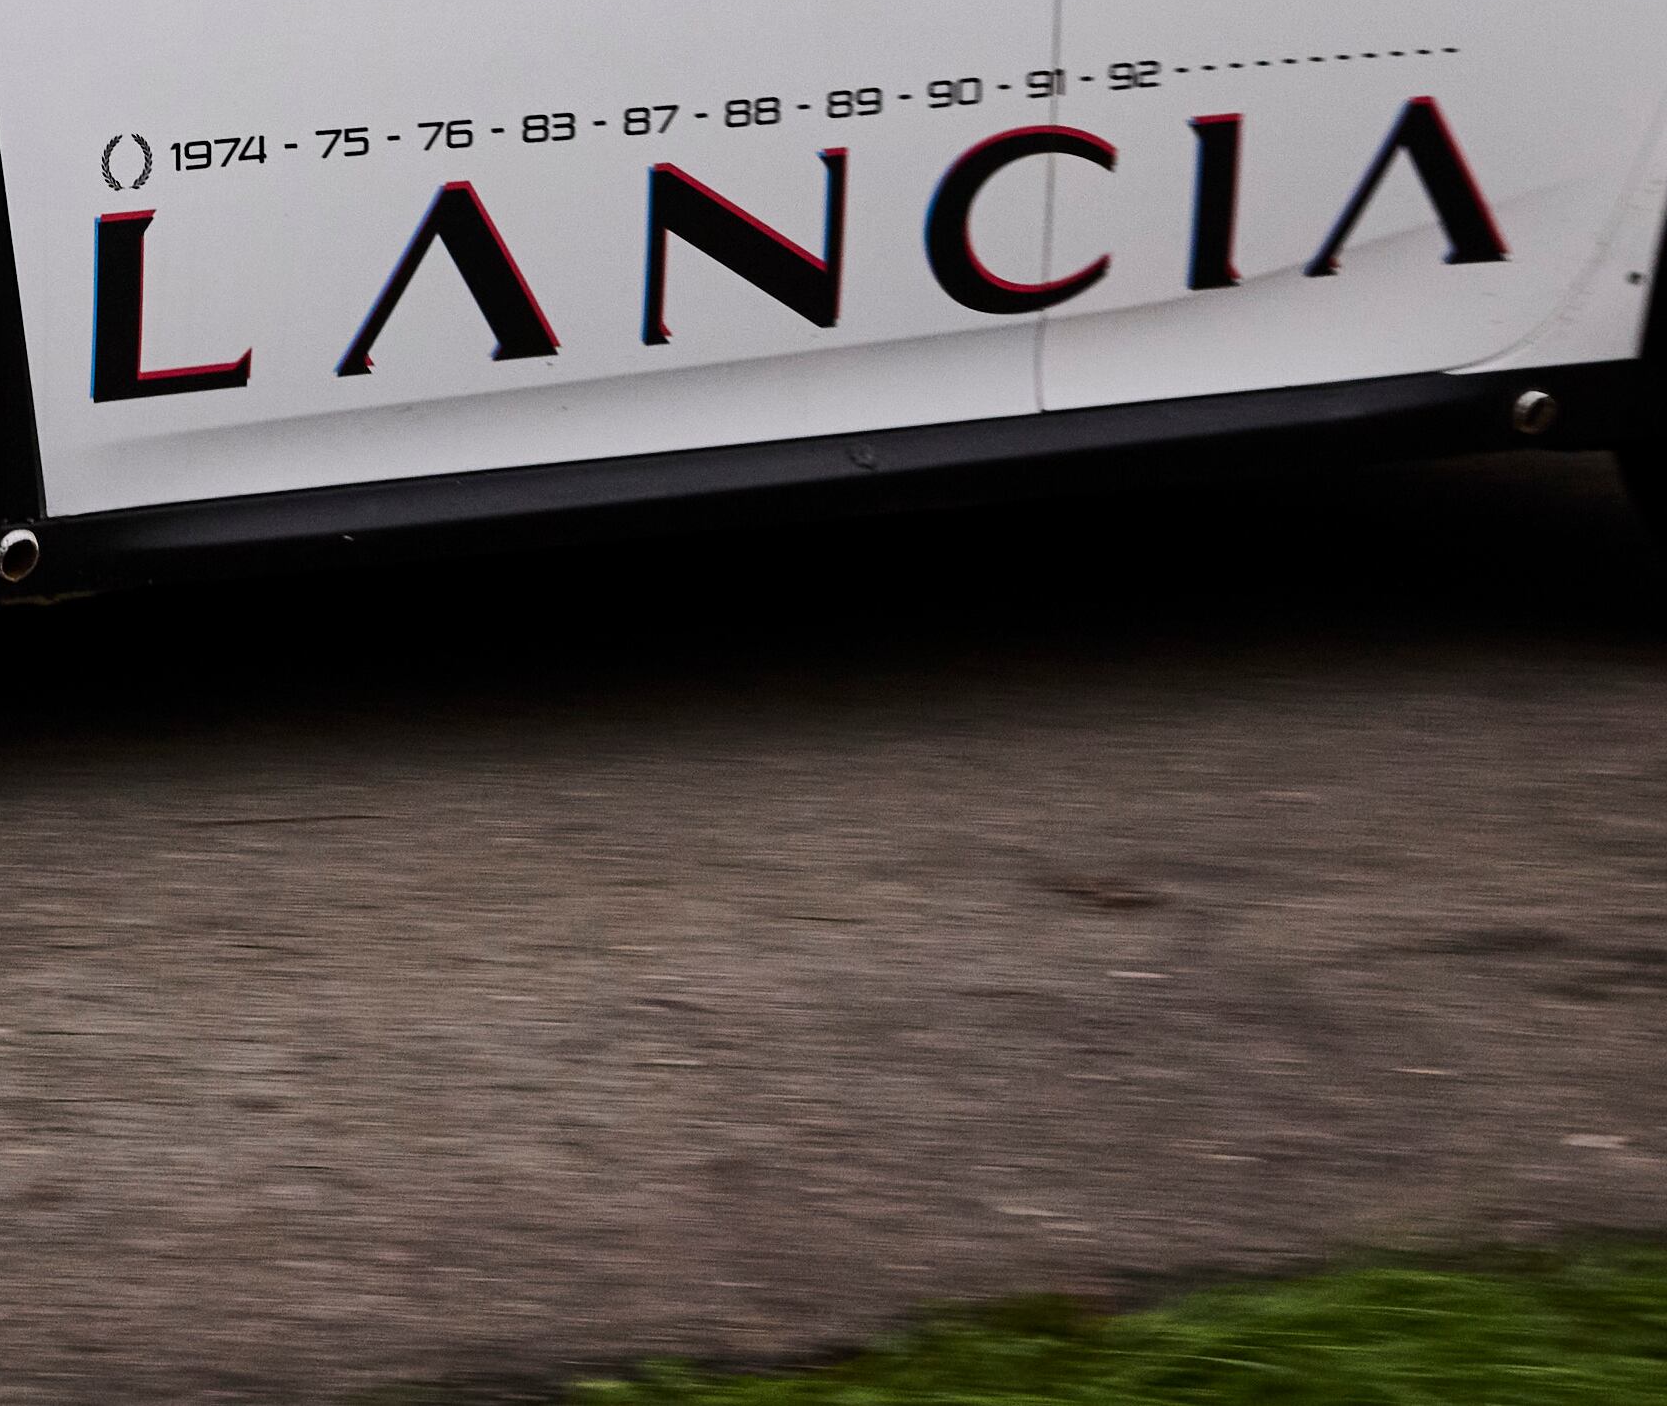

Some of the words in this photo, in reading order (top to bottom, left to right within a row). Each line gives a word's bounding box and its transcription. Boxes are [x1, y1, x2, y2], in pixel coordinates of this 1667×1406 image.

[170, 135, 268, 172] 1974
[314, 126, 370, 159] 75
[417, 119, 474, 152] 76
[522, 112, 576, 144] 83
[623, 104, 680, 136] 87
[724, 96, 781, 128] 88
[826, 87, 883, 119] 89
[927, 77, 982, 109] 90
[1026, 68, 1065, 99] 91
[1108, 60, 1161, 91] 92
[89, 95, 1510, 404] LANCIA
